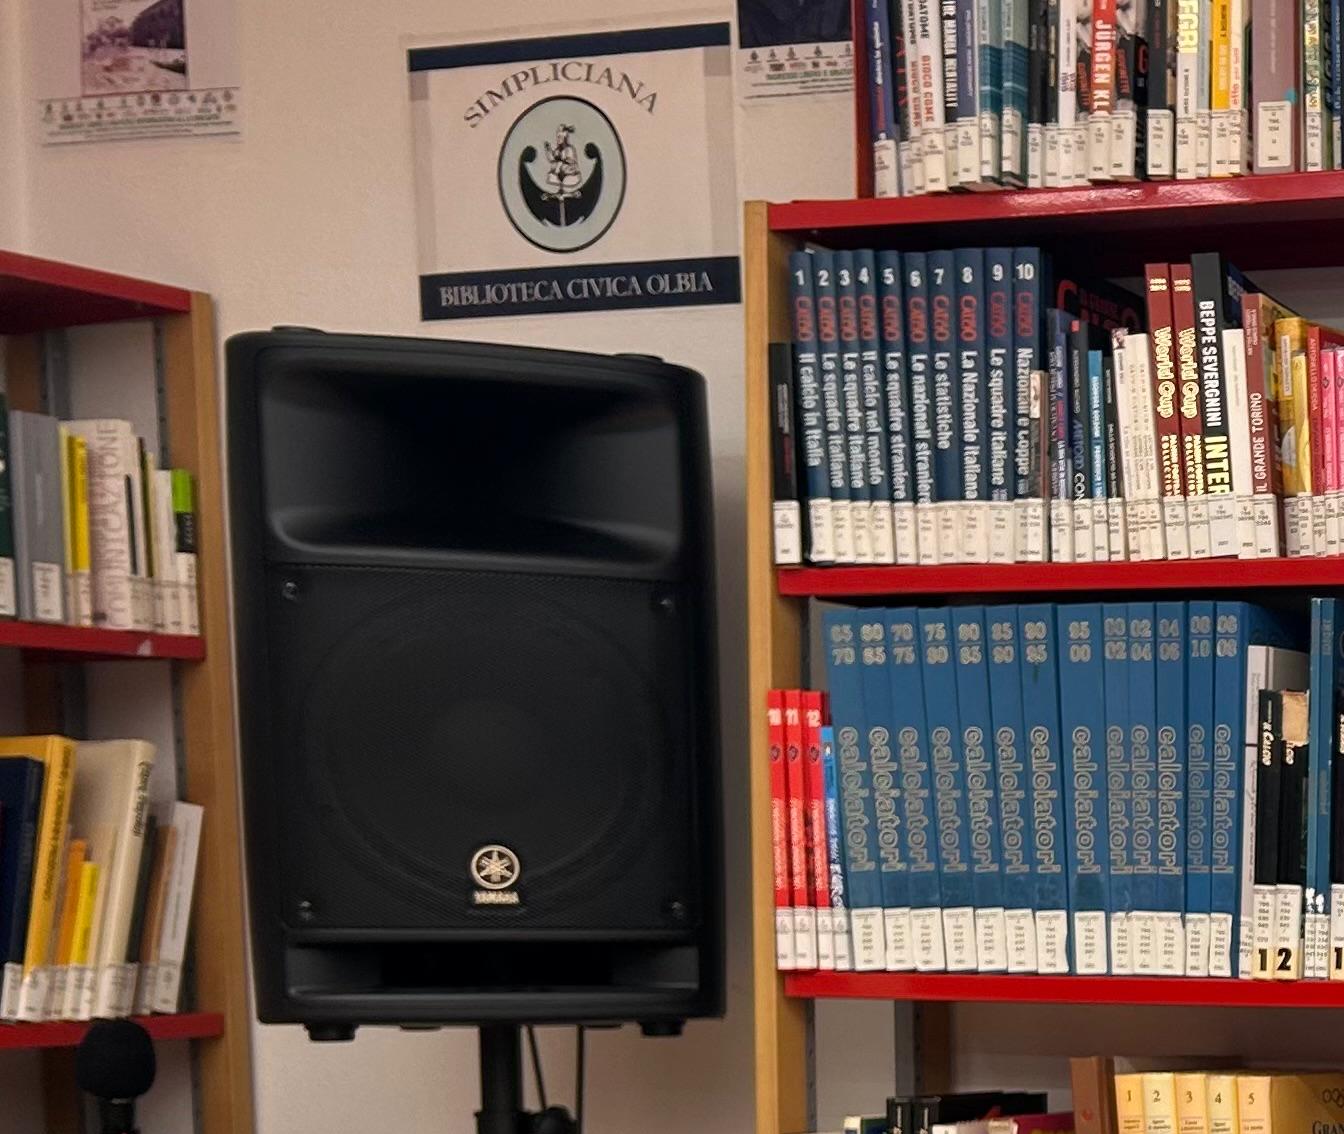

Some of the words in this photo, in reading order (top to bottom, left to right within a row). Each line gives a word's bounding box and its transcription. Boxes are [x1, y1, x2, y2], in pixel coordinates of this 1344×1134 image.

[1095, 20, 1116, 83] JÜRGEN
[464, 61, 660, 129] SIMPLICIANA
[440, 280, 564, 306] BIBLIOTECA
[567, 276, 642, 300] CIVICA
[646, 271, 714, 295] OLBIA
[795, 269, 805, 286] 1
[818, 269, 830, 286] 2
[839, 269, 850, 286] 3
[858, 267, 869, 284] 4
[883, 268, 894, 285] 5
[910, 270, 921, 287] 6
[934, 269, 945, 284] 7
[962, 266, 973, 283] 8
[992, 264, 1004, 281] 9
[1016, 263, 1034, 280] 10
[1199, 300, 1216, 344] BEPPE
[822, 353, 837, 370] Le
[886, 352, 901, 370] Le
[935, 353, 950, 370] Le
[1154, 326, 1175, 380] World
[823, 373, 842, 432] squadre
[863, 363, 880, 408] calcio
[886, 373, 905, 432] squadre
[1157, 380, 1176, 419] Cup
[1201, 346, 1222, 427] SEVERGNINI
[866, 410, 882, 433] nel
[936, 373, 952, 450] statistiche
[1251, 392, 1262, 434] TORINO
[867, 436, 884, 485] mondo
[1254, 436, 1266, 480] GRANDE
[924, 623, 947, 641] 75
[991, 622, 1013, 641] 85
[1069, 621, 1091, 641] 95
[894, 646, 915, 664] 75
[838, 725, 876, 873] calciatori
[900, 725, 936, 872] calciatori
[997, 725, 1030, 873] calciatori
[1072, 726, 1101, 874] calciatori
[1158, 726, 1183, 875] calciatori
